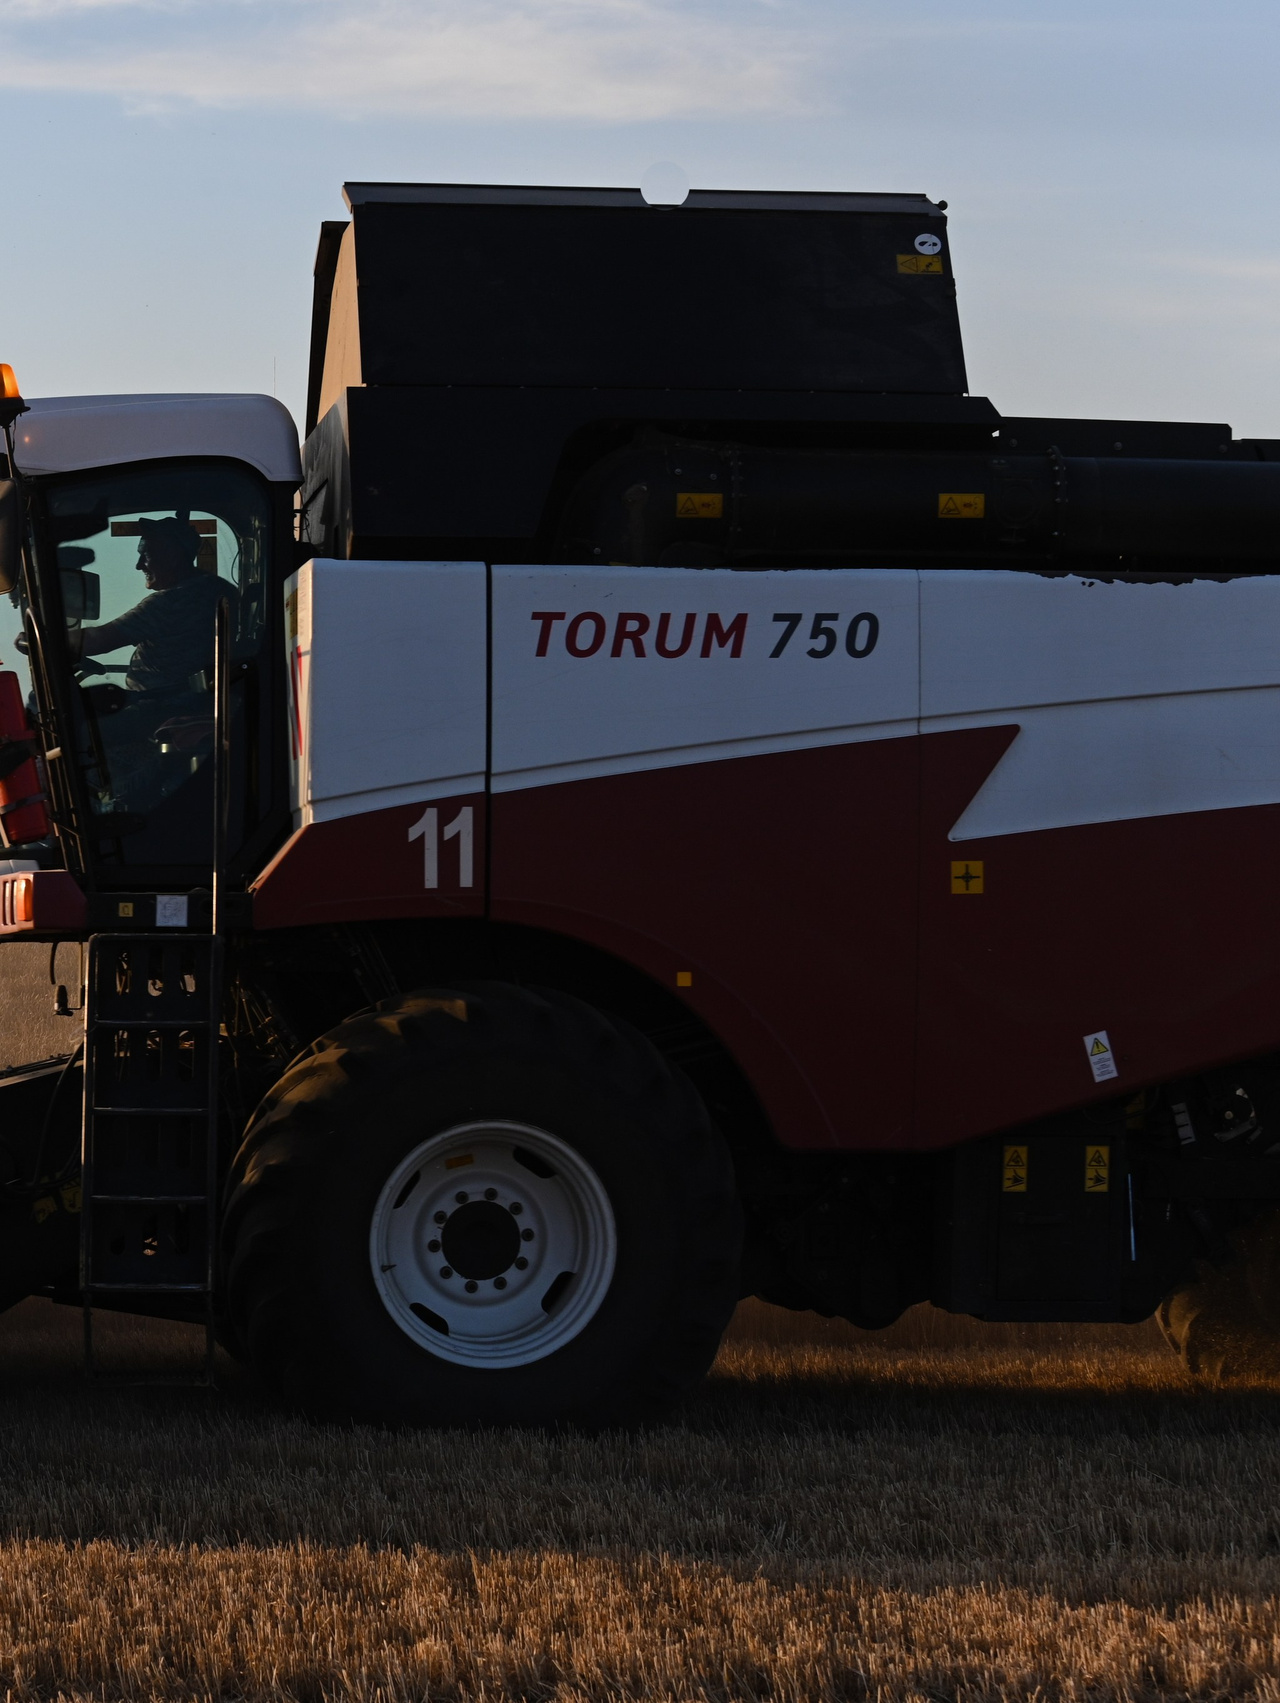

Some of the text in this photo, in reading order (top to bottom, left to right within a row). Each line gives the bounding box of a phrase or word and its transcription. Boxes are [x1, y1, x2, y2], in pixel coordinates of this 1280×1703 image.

[530, 611, 880, 658] TORUM 750
[407, 805, 474, 889] 11
